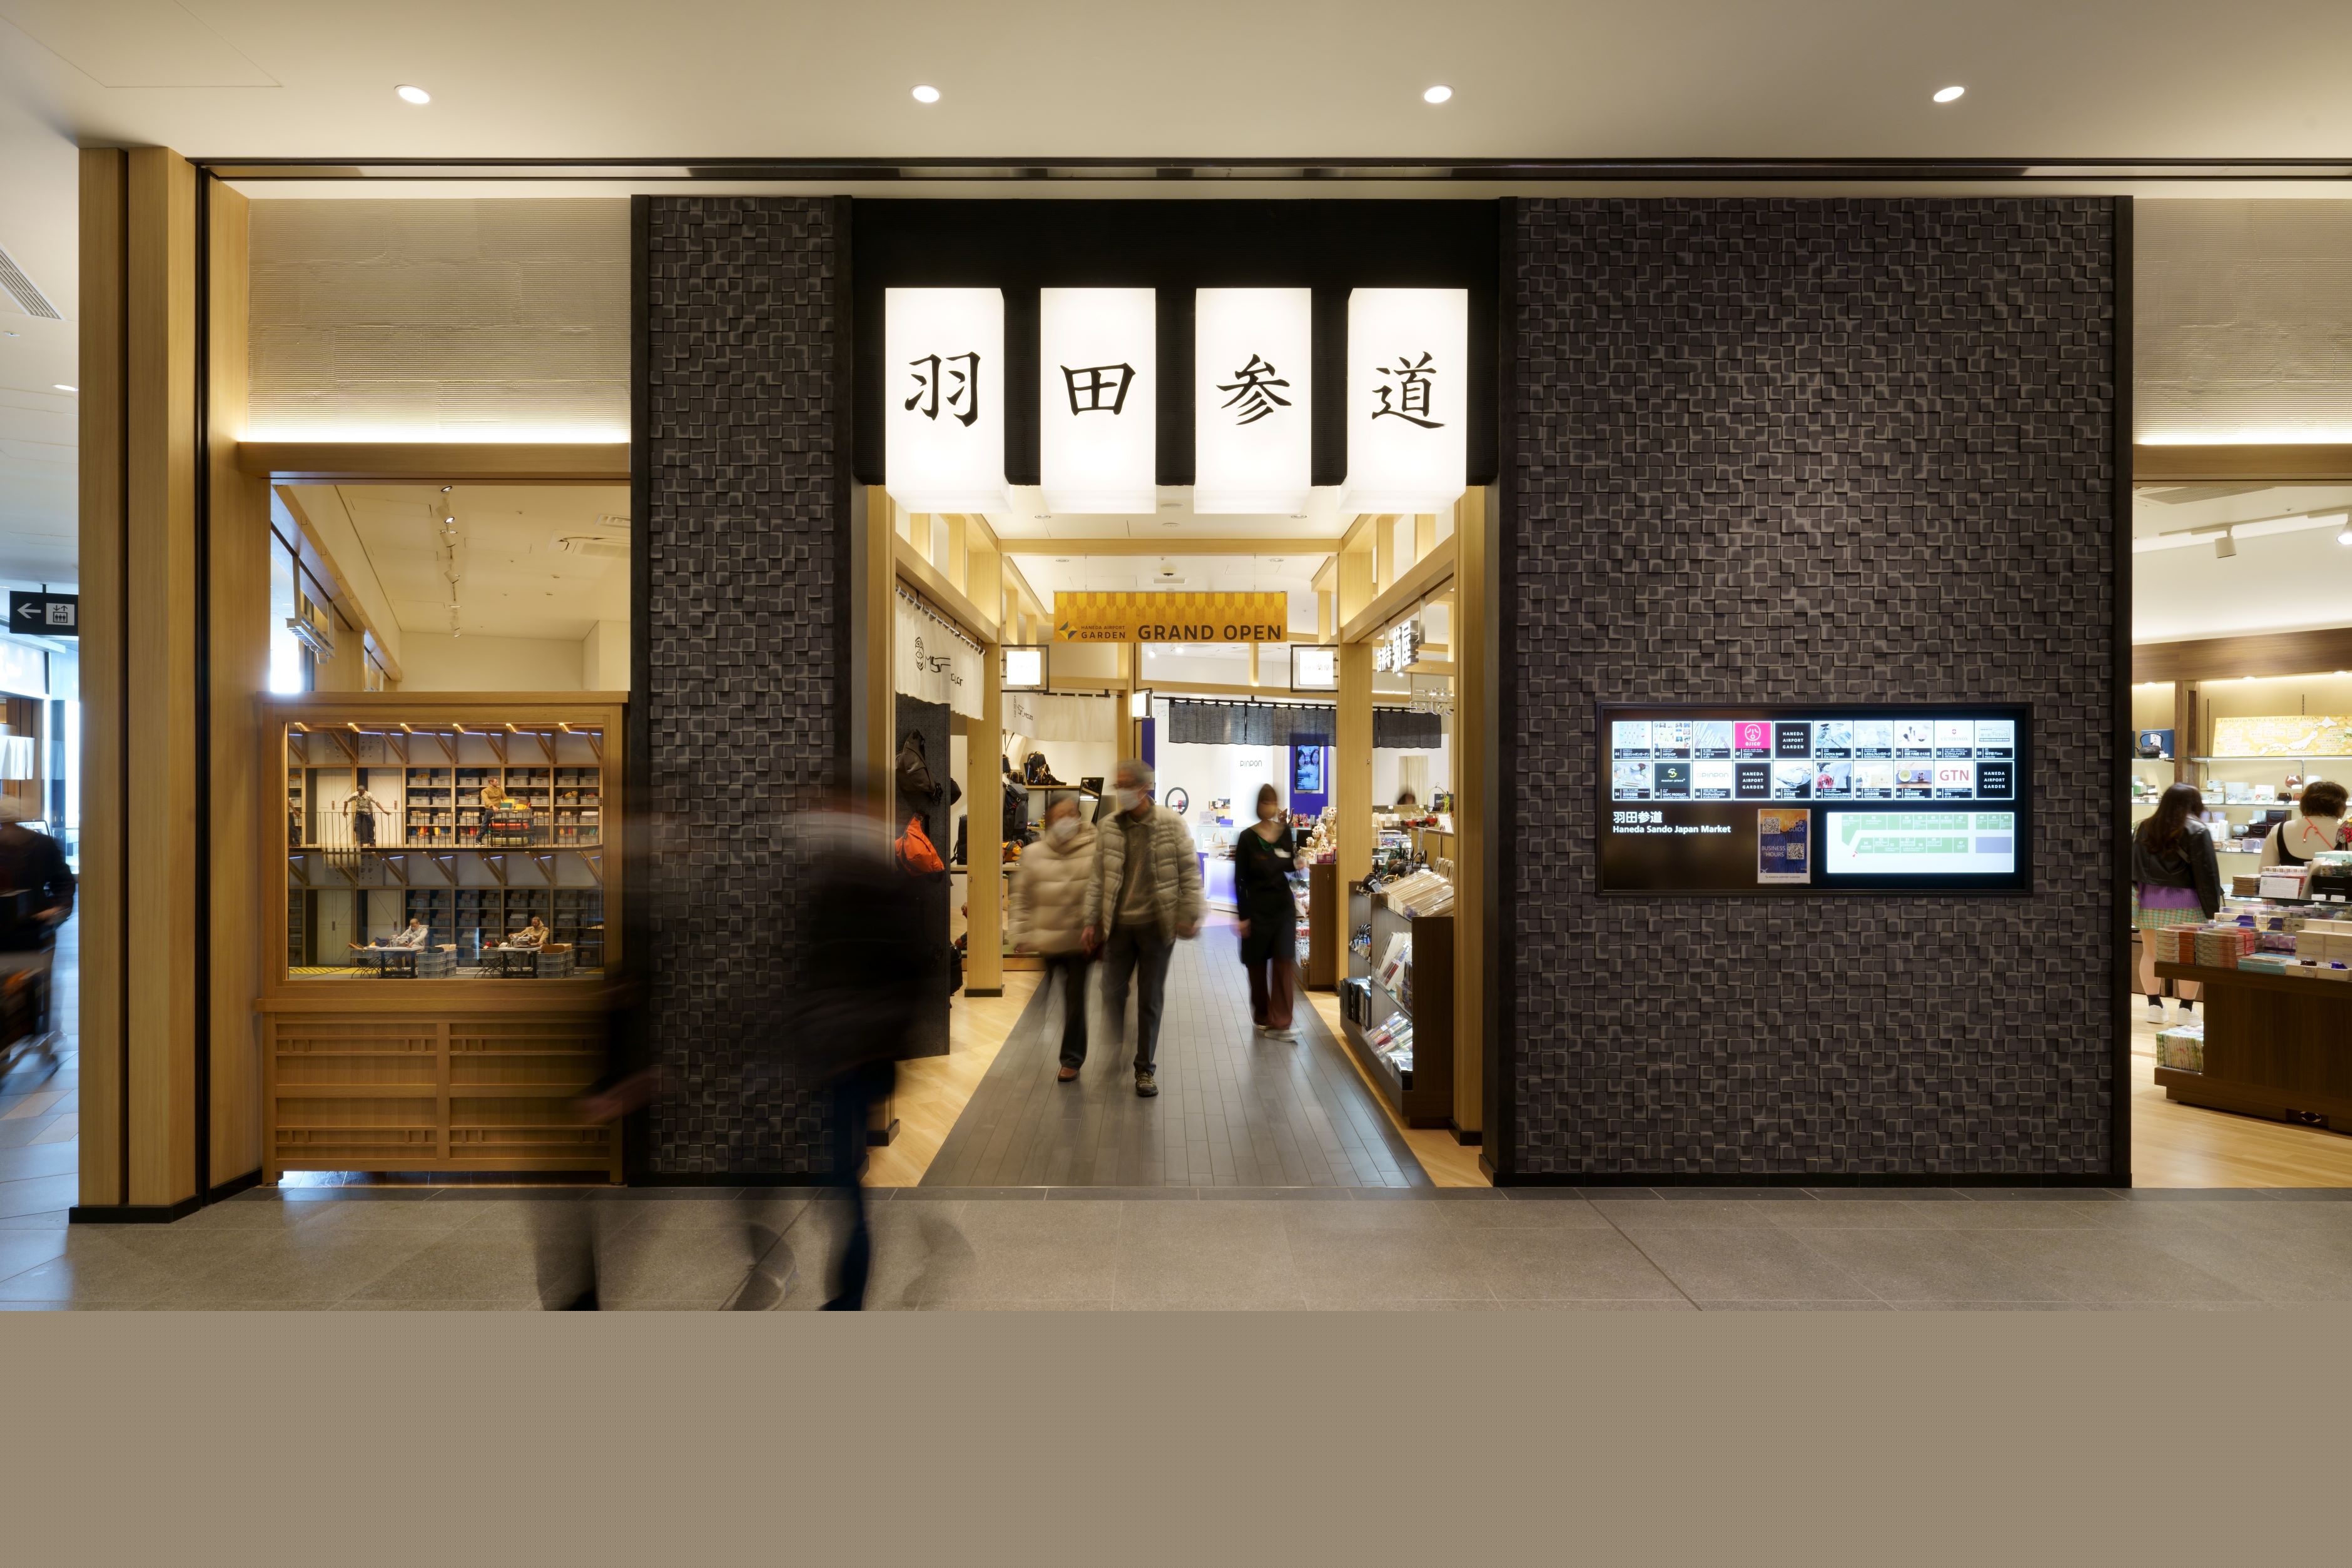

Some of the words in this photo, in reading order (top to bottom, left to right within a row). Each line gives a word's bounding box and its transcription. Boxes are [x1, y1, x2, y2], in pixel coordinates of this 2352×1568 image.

[905, 352, 1446, 429] 羽田参道
[1138, 625, 1214, 640] GRAND
[1224, 625, 1282, 640] OPEN
[1939, 769, 1969, 781] GTN
[1613, 811, 1663, 823] 羽田参道
[1674, 826, 1699, 834] Japan
